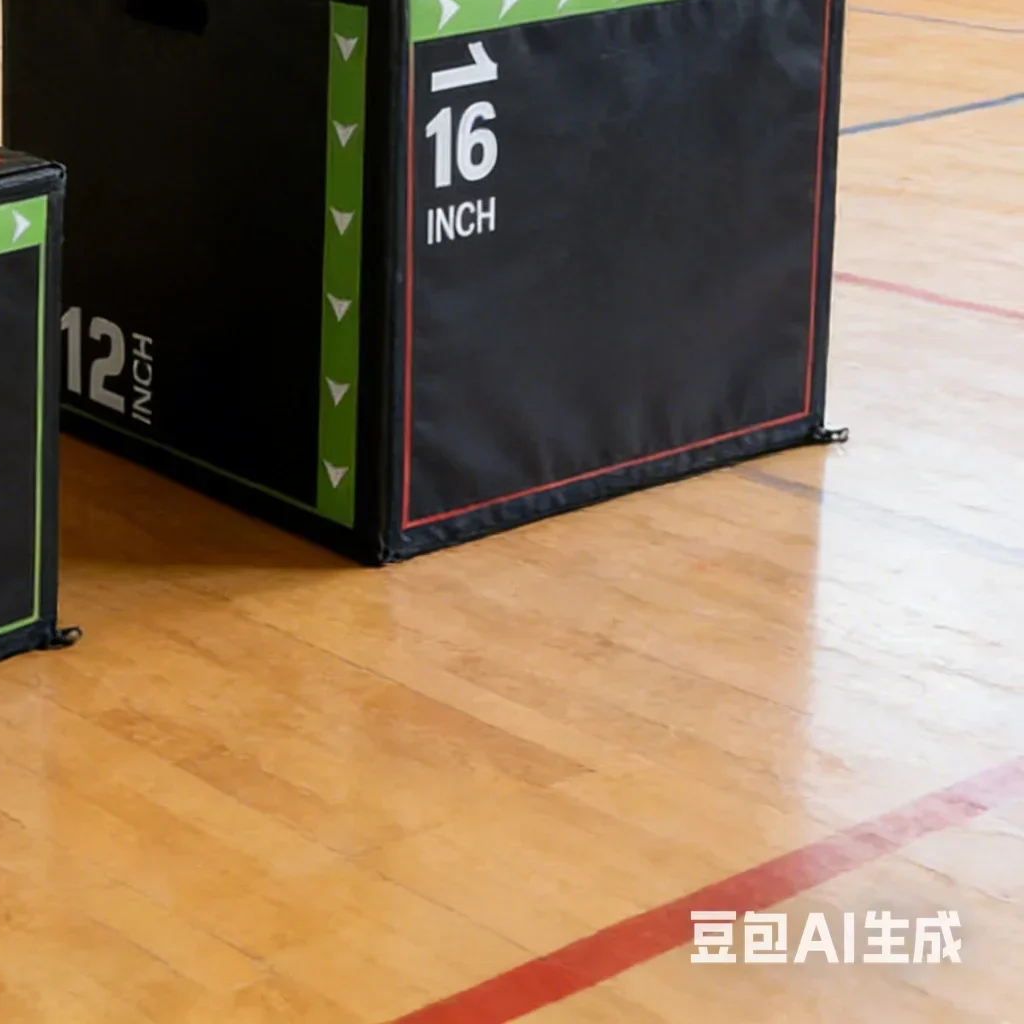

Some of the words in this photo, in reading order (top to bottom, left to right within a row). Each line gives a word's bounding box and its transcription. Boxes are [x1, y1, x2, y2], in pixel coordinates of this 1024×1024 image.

[425, 101, 498, 188] 16
[427, 196, 496, 245] INCH
[60, 306, 125, 414] 12
[131, 332, 153, 425] INCH
